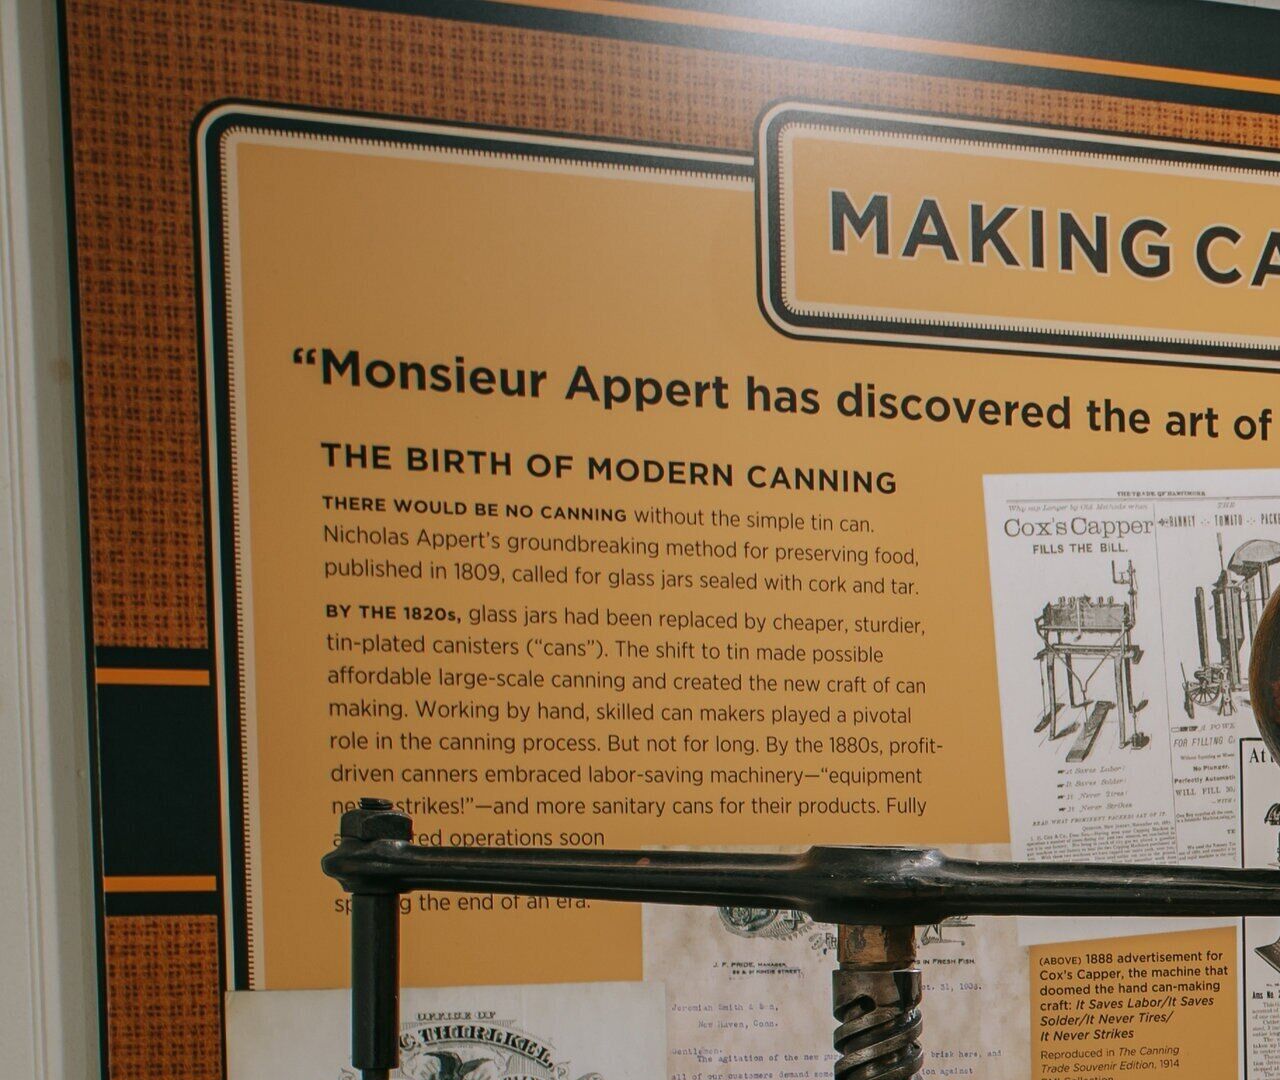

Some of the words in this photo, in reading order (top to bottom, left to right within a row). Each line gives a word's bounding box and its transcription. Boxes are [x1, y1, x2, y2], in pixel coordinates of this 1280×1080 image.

[830, 190, 1171, 279] MAKING
[291, 344, 548, 399] “Monsieur
[563, 363, 729, 413] Appert
[745, 374, 821, 415] has
[836, 381, 1071, 430] discovered
[1085, 397, 1151, 435] the
[1164, 406, 1219, 439] art
[1232, 407, 1273, 442] of
[319, 440, 392, 471] THE
[405, 445, 512, 477] BIRTH
[525, 452, 574, 479] OF
[587, 455, 733, 487] MODERN
[746, 464, 896, 495] CANNING
[320, 493, 387, 513] THERE
[392, 497, 468, 516] WOULD
[473, 501, 499, 518] BE
[504, 503, 534, 519] NO
[539, 504, 627, 523] CANNING
[633, 505, 705, 527] without
[710, 508, 741, 528] the
[746, 510, 805, 532] simple
[810, 513, 833, 531] tin
[838, 518, 874, 533] can.
[1002, 516, 1068, 538] Cox's
[1069, 515, 1154, 540] Capper
[321, 523, 410, 547] Nicholas
[415, 527, 501, 551] Appert’s
[506, 533, 659, 559] groundbreaking
[665, 538, 737, 559] method
[742, 540, 769, 560] for
[774, 544, 868, 567] preserving
[873, 545, 919, 567] food,
[1031, 542, 1065, 555] FILLS
[1067, 542, 1093, 554] THE
[324, 602, 352, 619] BY
[357, 603, 397, 621] THE
[402, 605, 462, 625] 1820s,
[467, 603, 518, 626] glass
[522, 604, 558, 628] jars
[563, 605, 599, 626] had
[605, 607, 652, 627] been
[658, 609, 738, 631] replaced
[743, 611, 767, 633] by
[771, 612, 848, 635] cheaper,
[853, 615, 925, 636] sturdier,
[1038, 955, 1082, 967] (ABOVE)
[1084, 952, 1114, 965] 1888
[1115, 950, 1203, 964] advertisement
[1205, 949, 1224, 962] for
[1038, 968, 1073, 981] Cox’s
[1075, 967, 1125, 982] Capper,
[1127, 966, 1148, 979] the
[1150, 964, 1202, 978] machine
[1203, 964, 1229, 977] that
